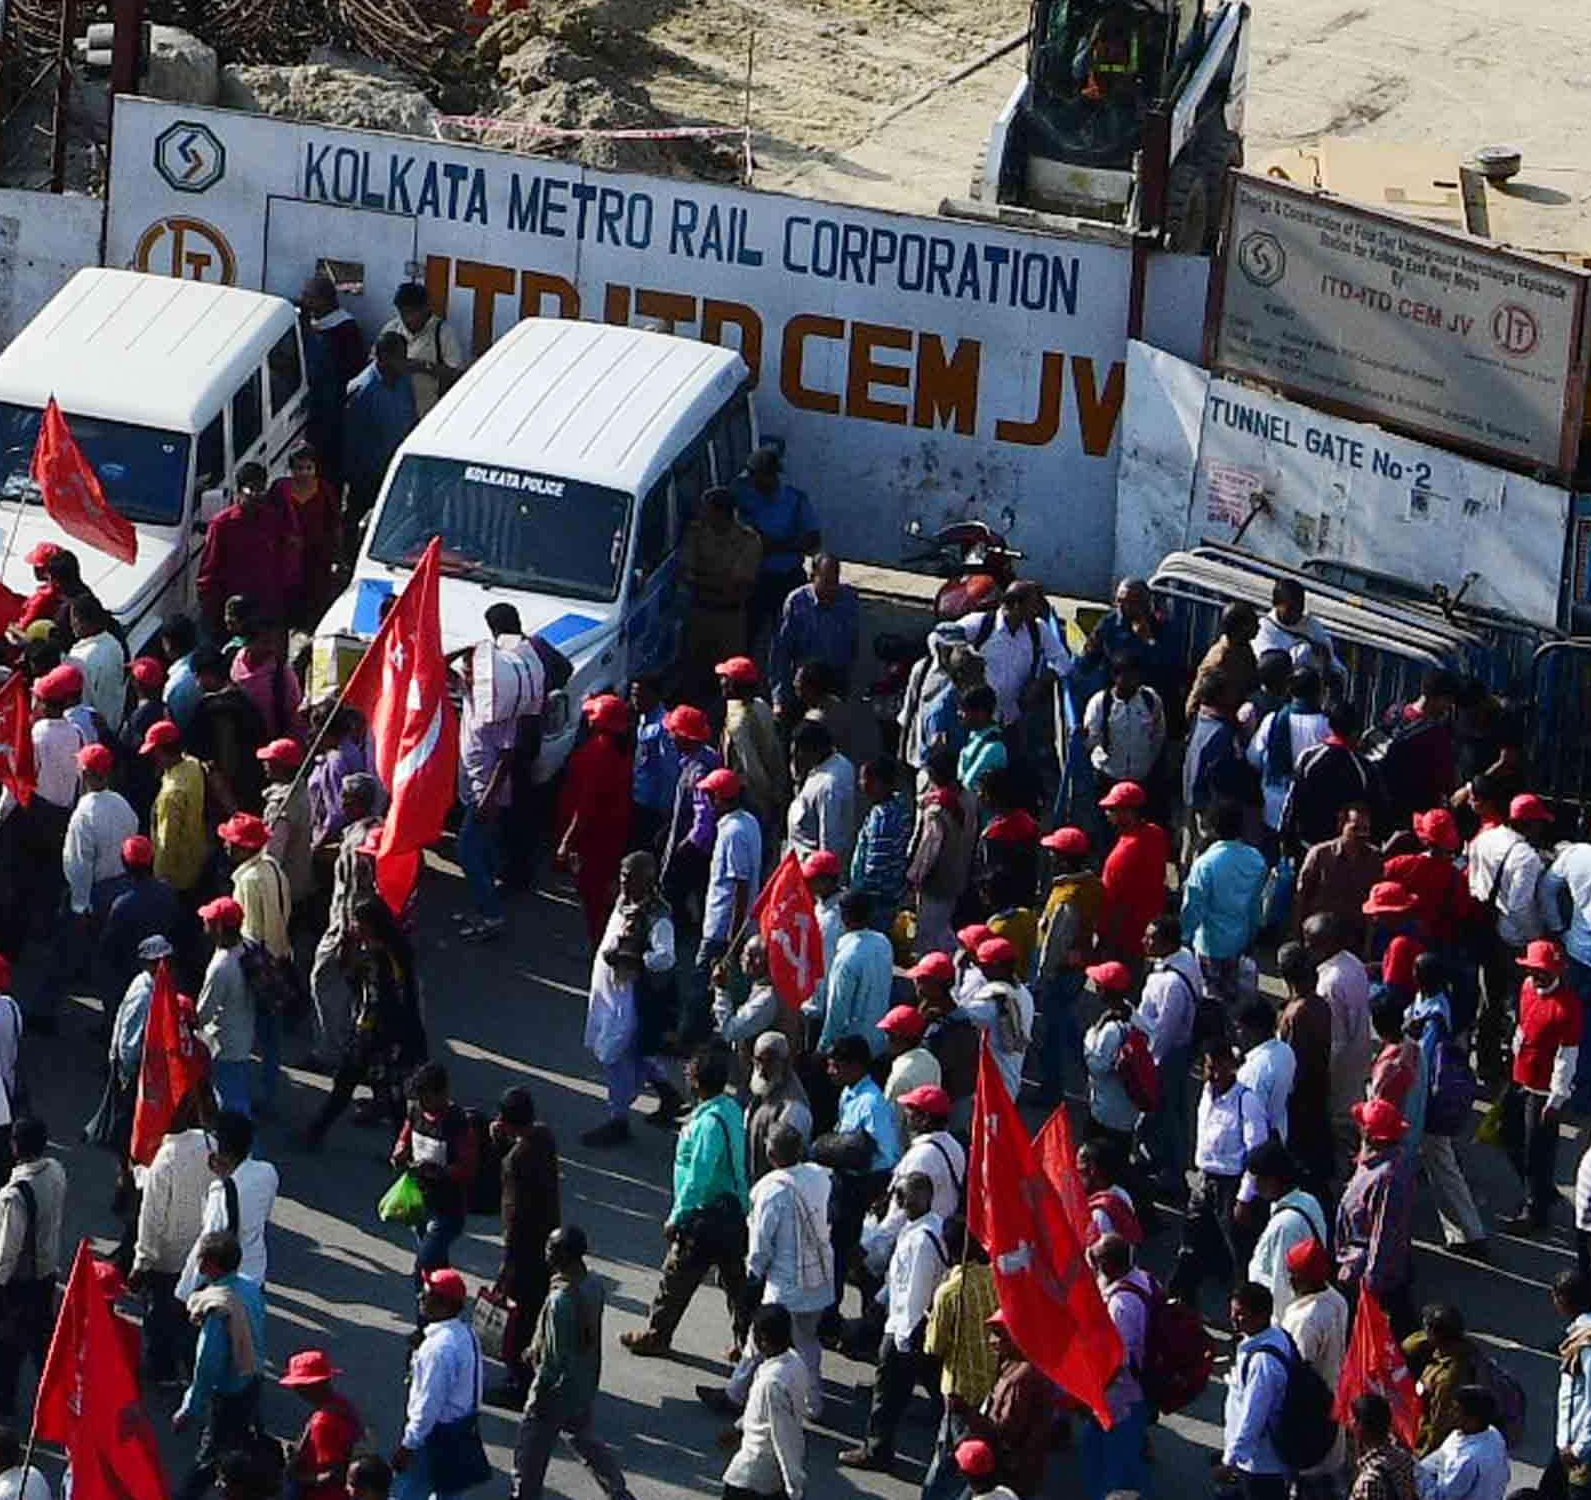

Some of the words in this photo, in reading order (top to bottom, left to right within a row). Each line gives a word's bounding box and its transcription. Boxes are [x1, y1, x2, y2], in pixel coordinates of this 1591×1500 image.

[305, 142, 489, 226] KOLKATA
[507, 172, 654, 251] METRO
[669, 198, 763, 268] RAIL
[782, 216, 1081, 316] CORPORATION
[1397, 298, 1444, 329] CEM
[1447, 313, 1476, 337] JV
[779, 312, 982, 438] CEM
[994, 350, 1127, 459] JV
[1209, 395, 1298, 449] TUNNEL
[1305, 427, 1364, 469] GATE
[464, 465, 519, 490] KOLKATA
[521, 473, 566, 498] POLICE
